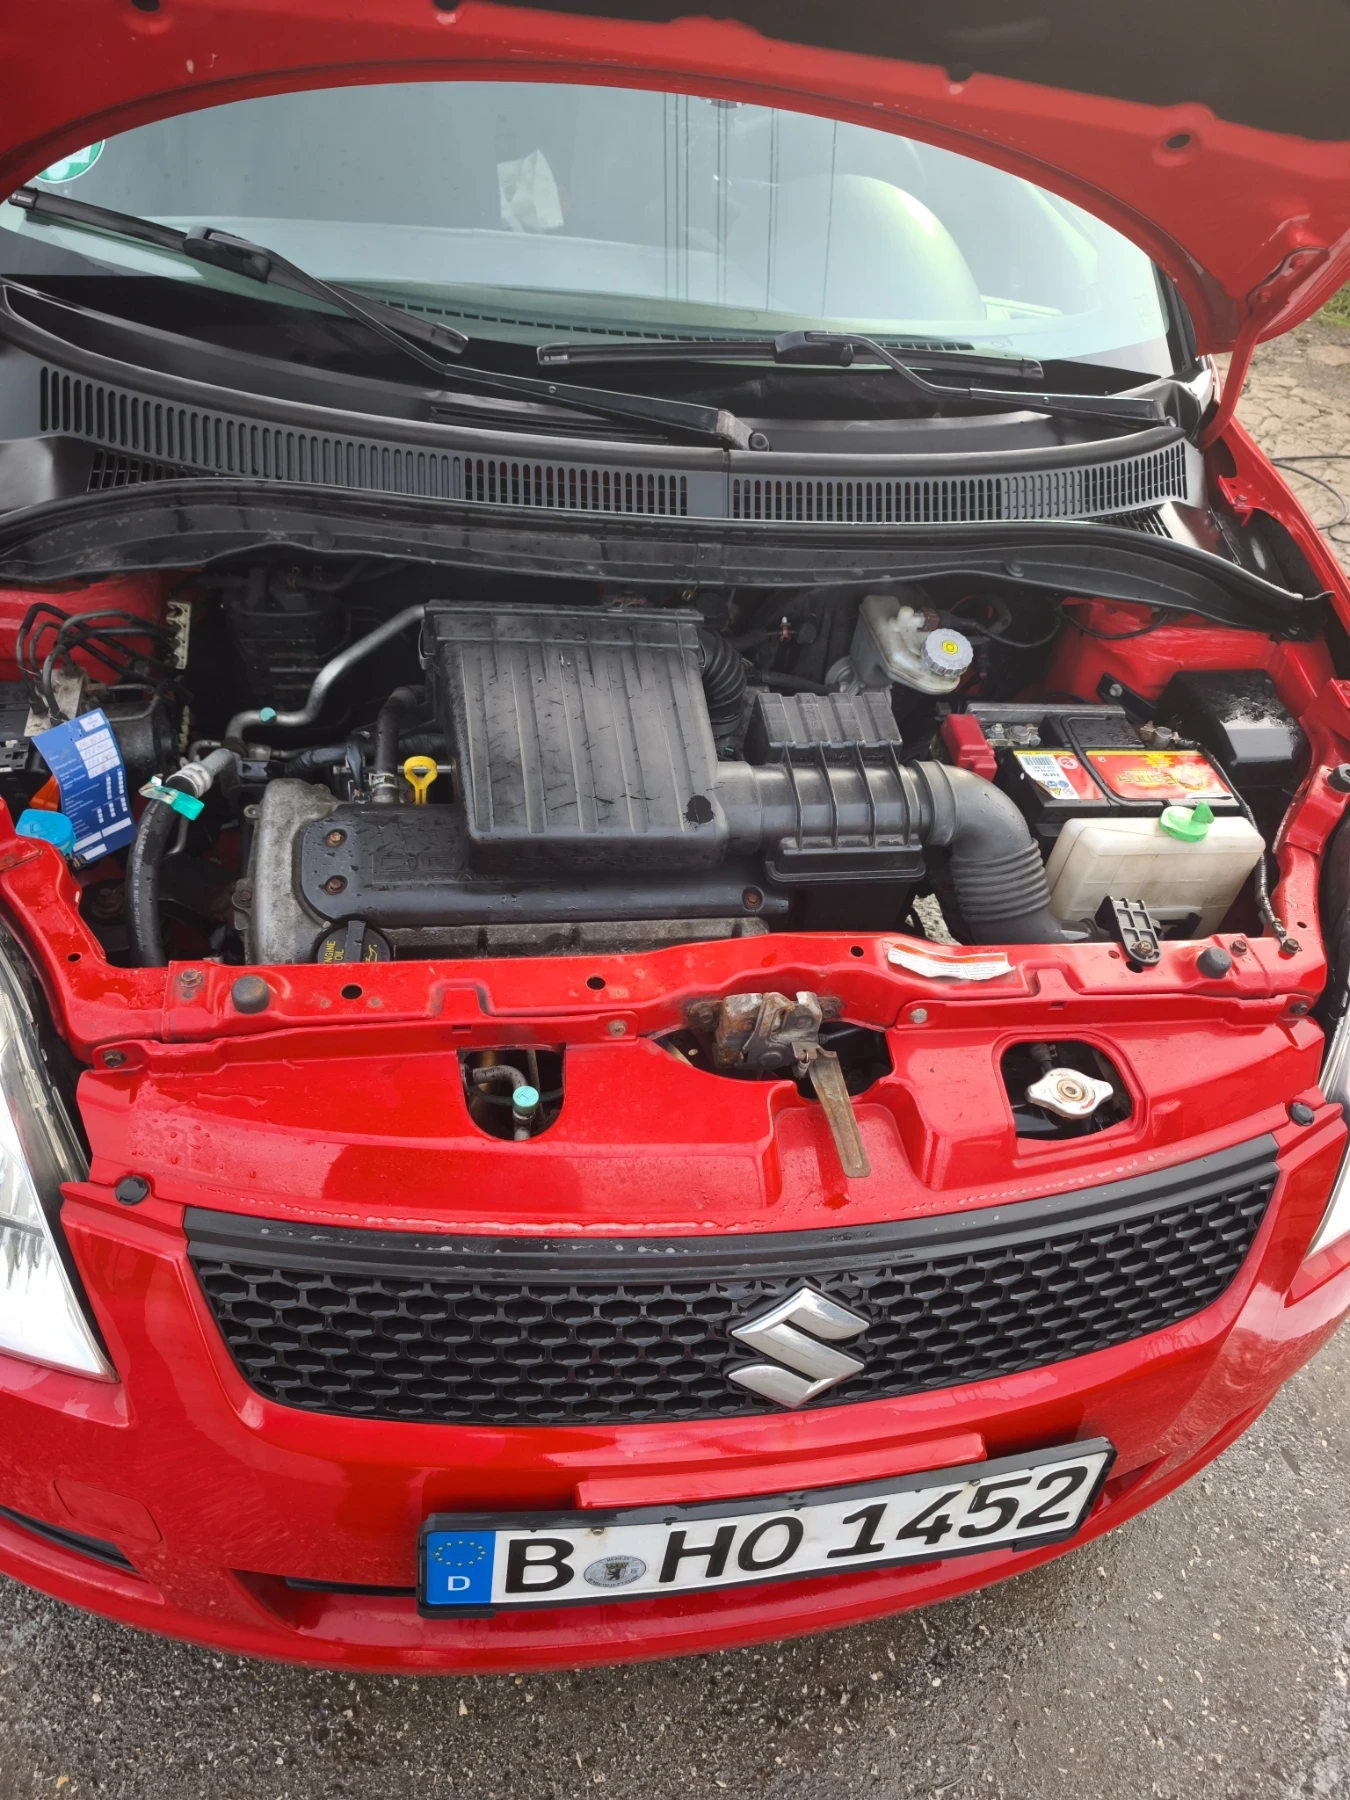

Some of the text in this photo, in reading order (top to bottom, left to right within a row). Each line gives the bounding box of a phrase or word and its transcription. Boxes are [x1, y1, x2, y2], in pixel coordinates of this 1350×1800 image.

[803, 695, 818, 728] SUZUKI
[323, 940, 336, 964] NGINE
[334, 949, 345, 961] OIL
[505, 1537, 575, 1594] B
[658, 1514, 805, 1583] HO
[826, 1465, 1088, 1558] 1452
[447, 1575, 471, 1591] D
